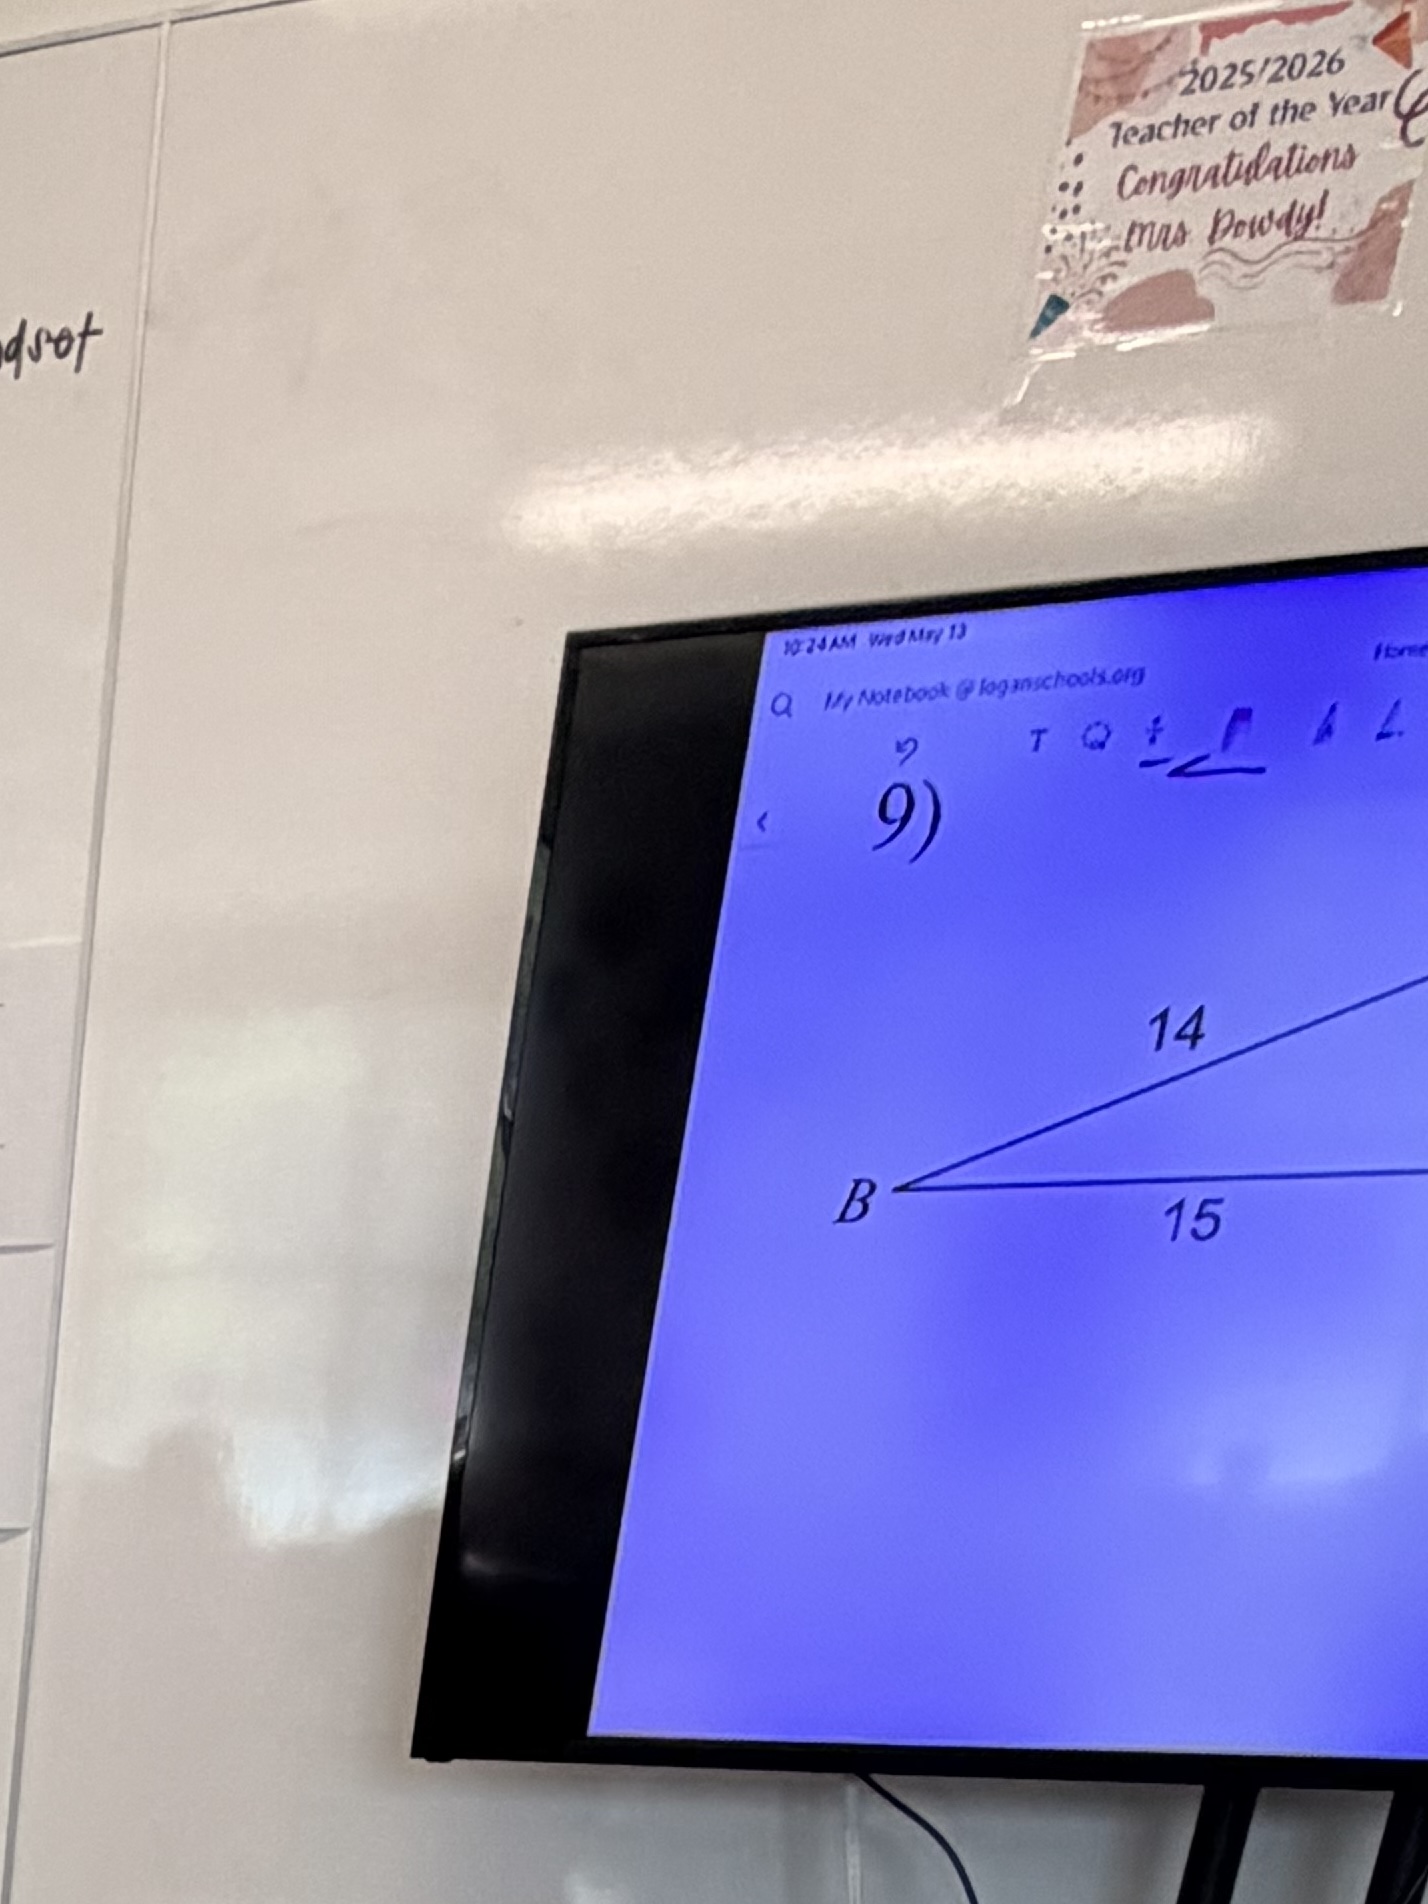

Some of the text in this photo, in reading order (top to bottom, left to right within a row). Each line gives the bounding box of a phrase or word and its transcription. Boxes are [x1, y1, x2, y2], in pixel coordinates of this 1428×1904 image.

[1179, 47, 1345, 96] 2025/2026
[1109, 89, 1393, 149] Teacher of the Year
[1117, 142, 1359, 201] Congratulations
[1125, 190, 1330, 253] Mrs Dowdy!
[948, 623, 967, 641] 13
[858, 682, 950, 707] Notebook
[871, 779, 942, 865] 9)
[1148, 1004, 1206, 1052] 14
[834, 1178, 878, 1224] B
[1164, 1197, 1225, 1242] 15
